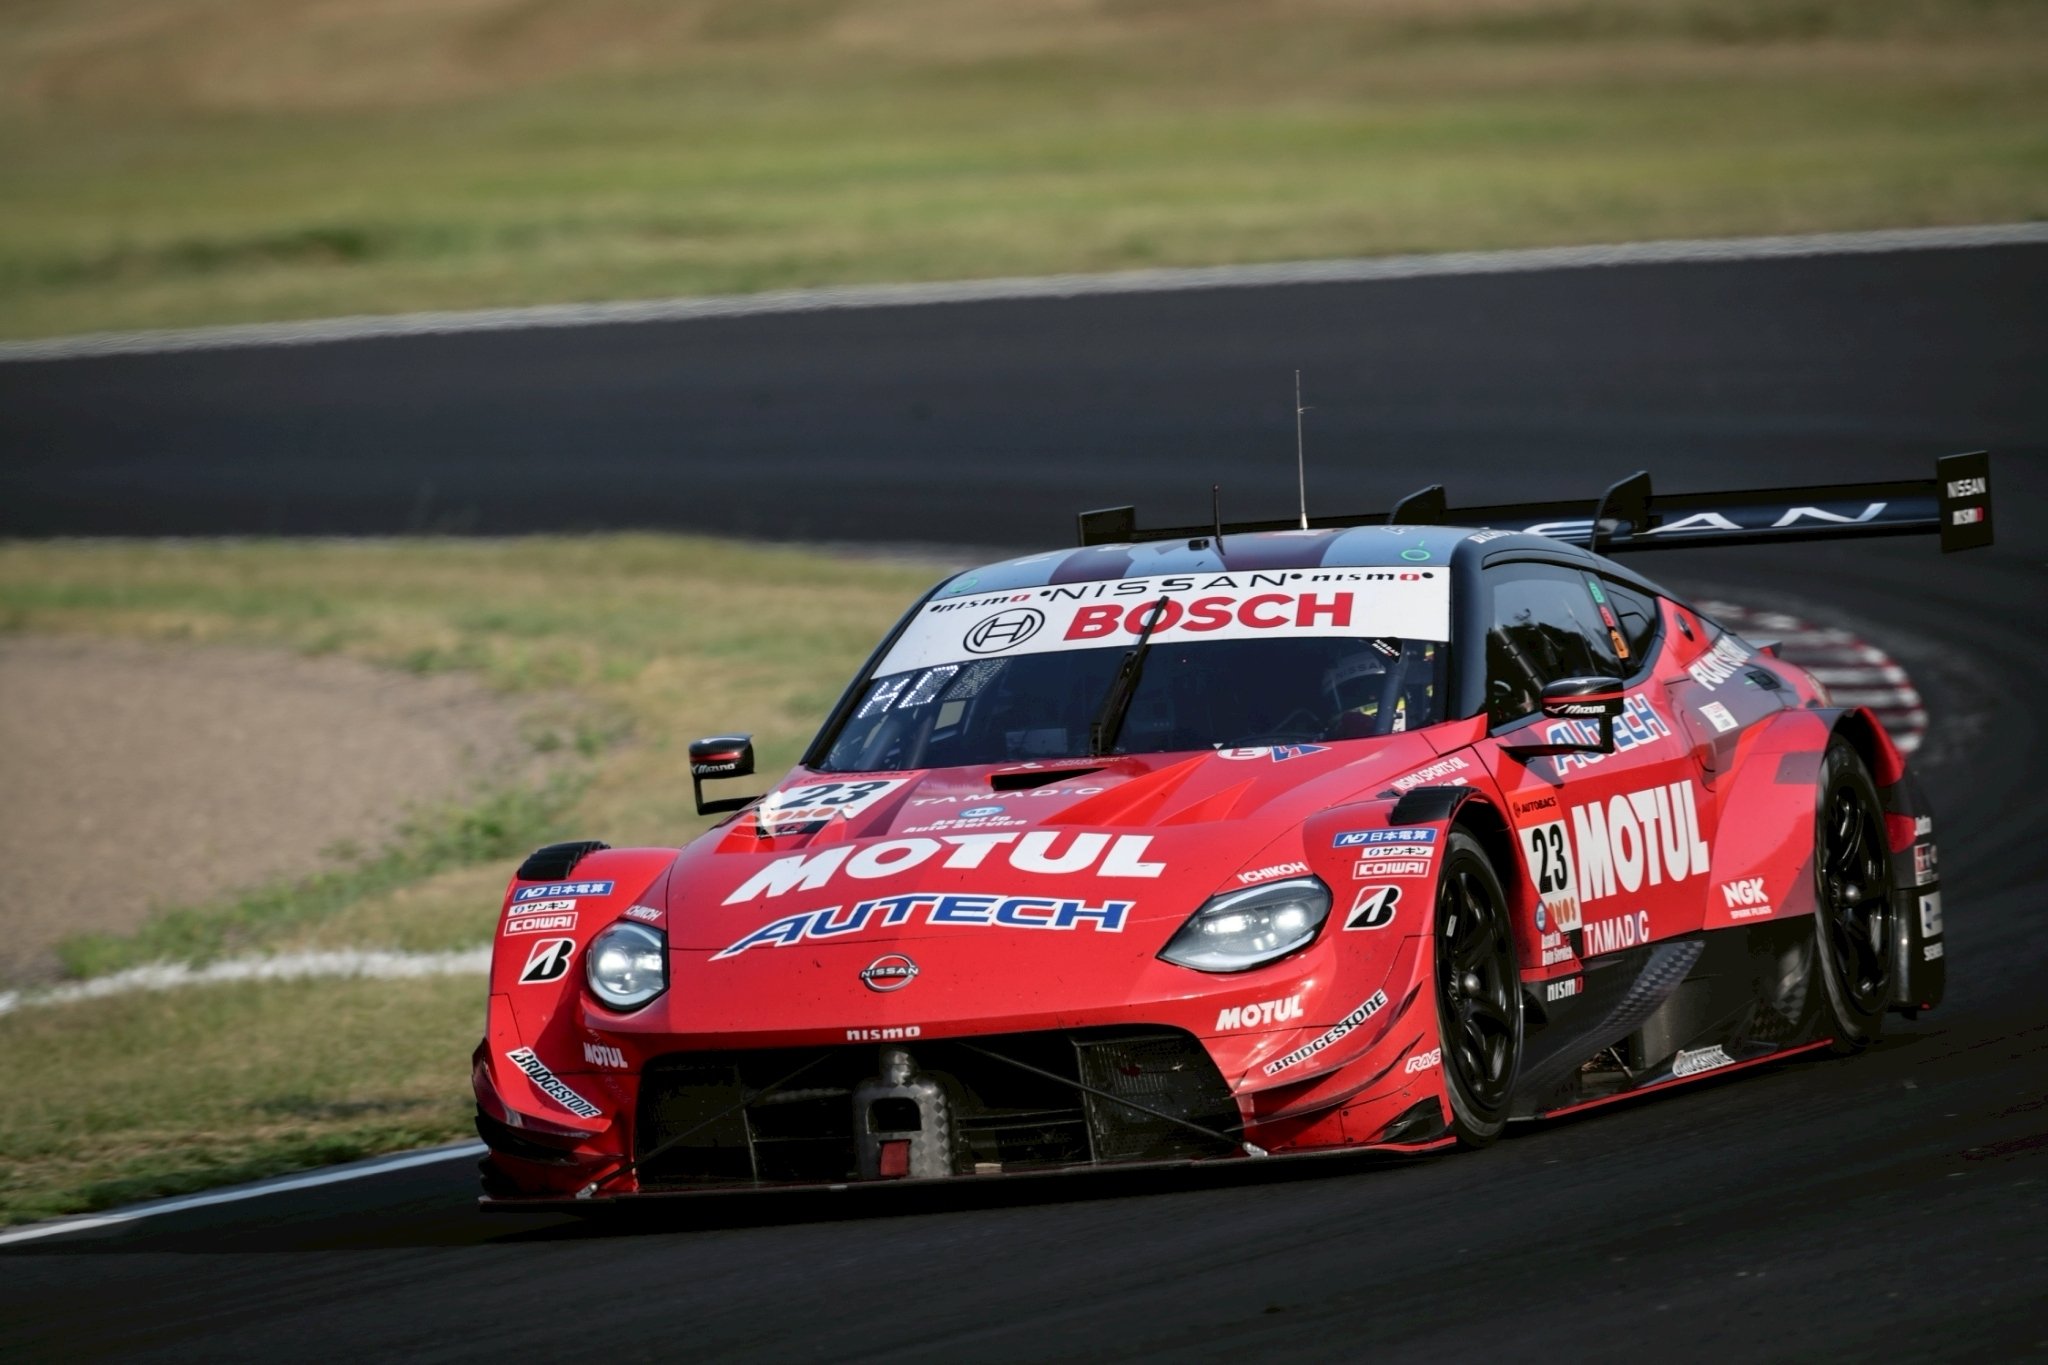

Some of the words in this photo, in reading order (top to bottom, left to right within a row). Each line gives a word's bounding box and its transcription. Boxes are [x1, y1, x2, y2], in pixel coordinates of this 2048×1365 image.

[1946, 476, 1986, 498] NISSAN
[1049, 573, 1288, 602] NISSAN
[1312, 573, 1420, 582] nismo
[937, 593, 1031, 613] nismo
[1063, 592, 1354, 641] BOSCH
[776, 781, 890, 810] 23
[911, 787, 1104, 806] TAMADIC
[951, 819, 1028, 830] Service
[1571, 779, 1710, 903] MOTUL
[721, 831, 1168, 906] MOTUL
[1237, 861, 1309, 884] ICHIKOH
[1531, 824, 1568, 894] 23
[1721, 877, 1769, 908] NGK
[708, 893, 1136, 962] AUTECH
[1583, 910, 1650, 956] TAMADIC
[860, 966, 920, 979] NISSAN
[1215, 994, 1304, 1032] MOTUL
[846, 1026, 921, 1041] nismo
[1266, 990, 1387, 1075] BRIDGESTONE
[583, 1042, 628, 1069] MOTUL
[510, 1048, 599, 1118] BRIDGESTONE
